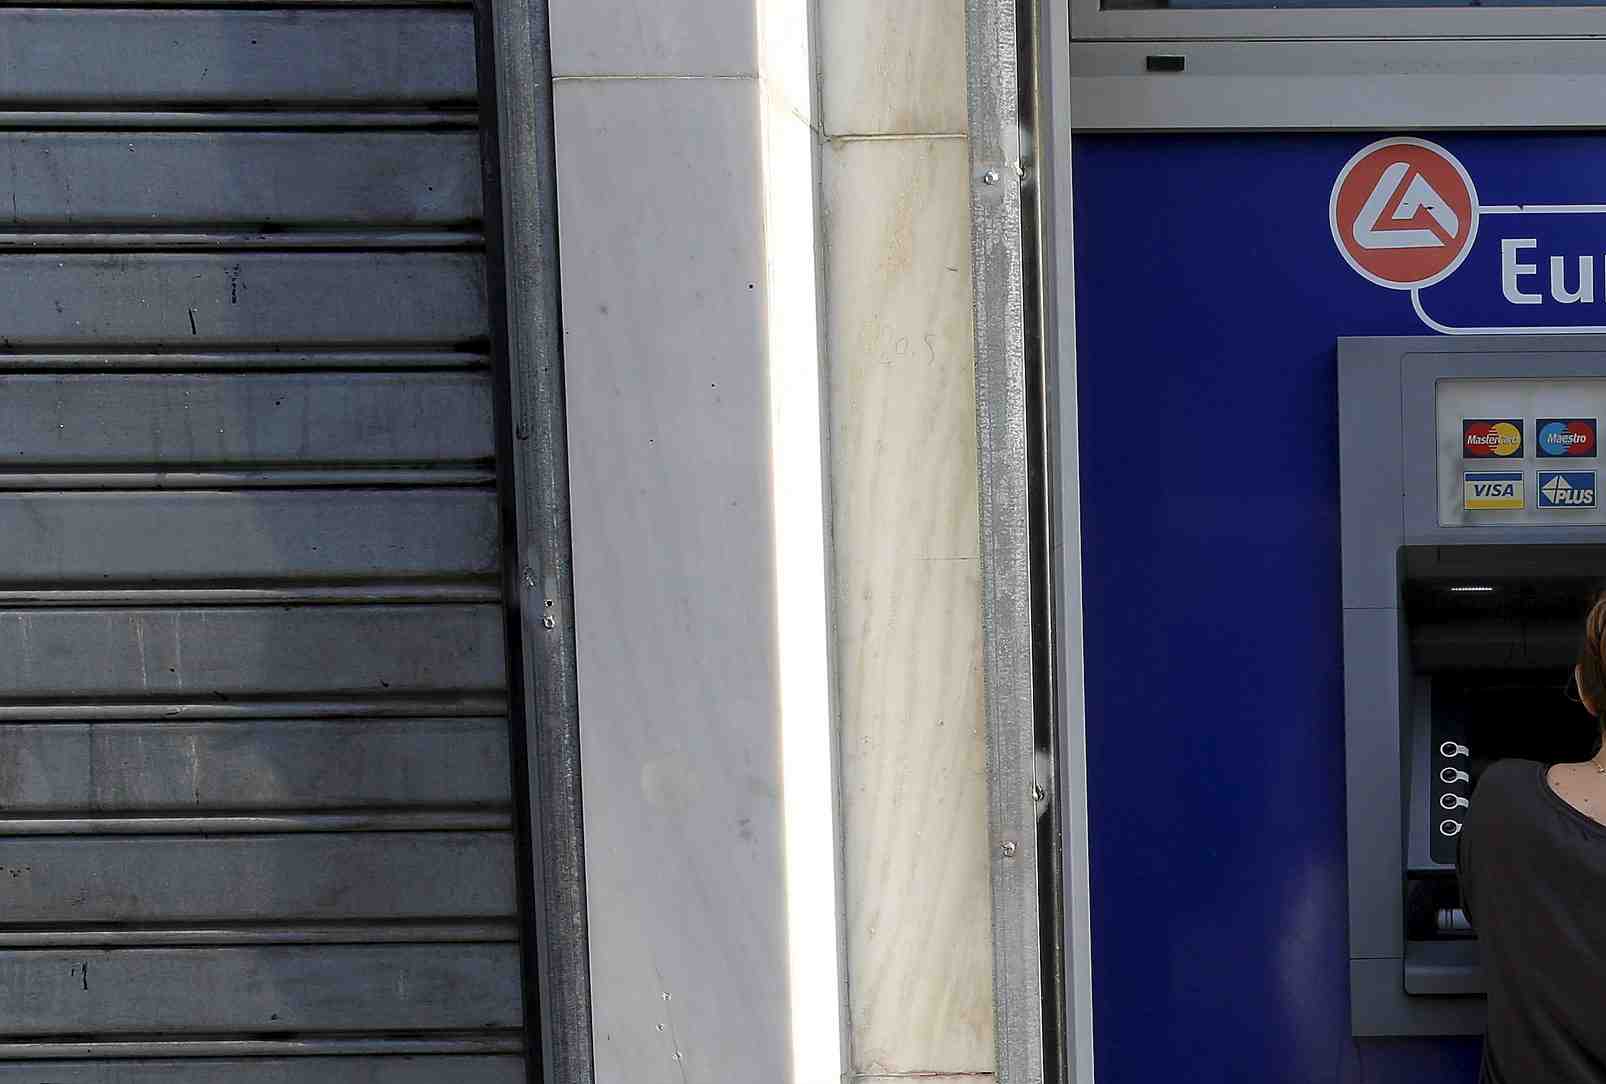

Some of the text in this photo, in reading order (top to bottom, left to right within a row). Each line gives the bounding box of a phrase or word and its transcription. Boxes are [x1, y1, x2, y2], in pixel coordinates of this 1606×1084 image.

[1547, 433, 1586, 444] Maestro
[1474, 484, 1514, 497] VISA
[1556, 489, 1593, 504] PLUS
